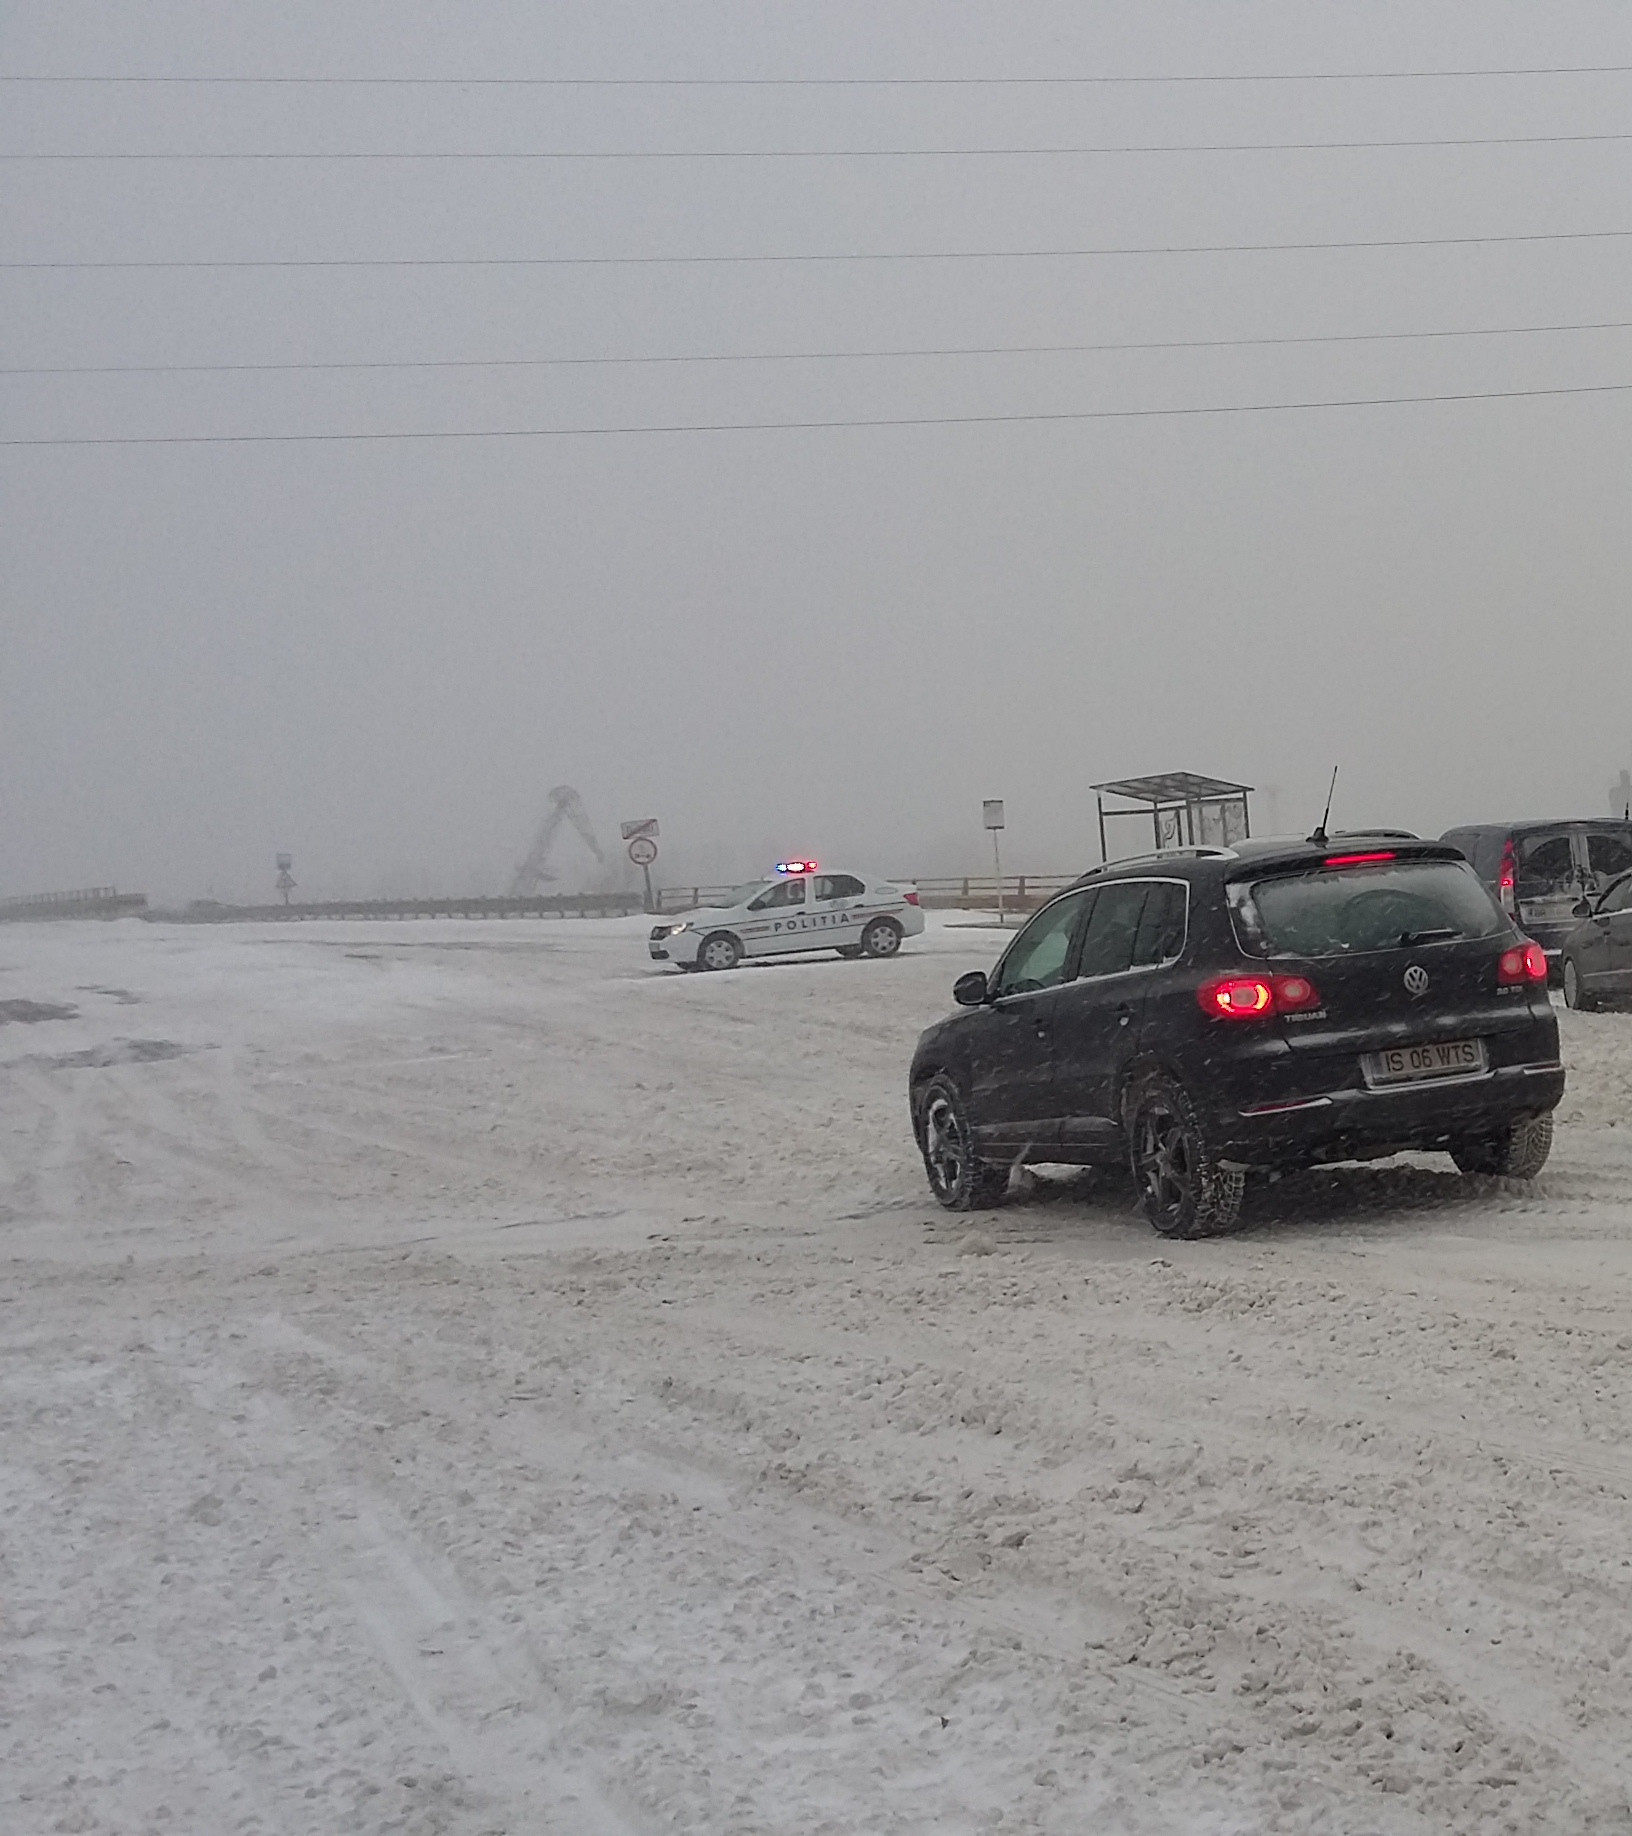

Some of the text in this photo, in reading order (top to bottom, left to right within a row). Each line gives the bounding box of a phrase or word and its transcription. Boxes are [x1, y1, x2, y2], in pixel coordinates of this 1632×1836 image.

[1385, 1044, 1474, 1073] IS 06 WTS
